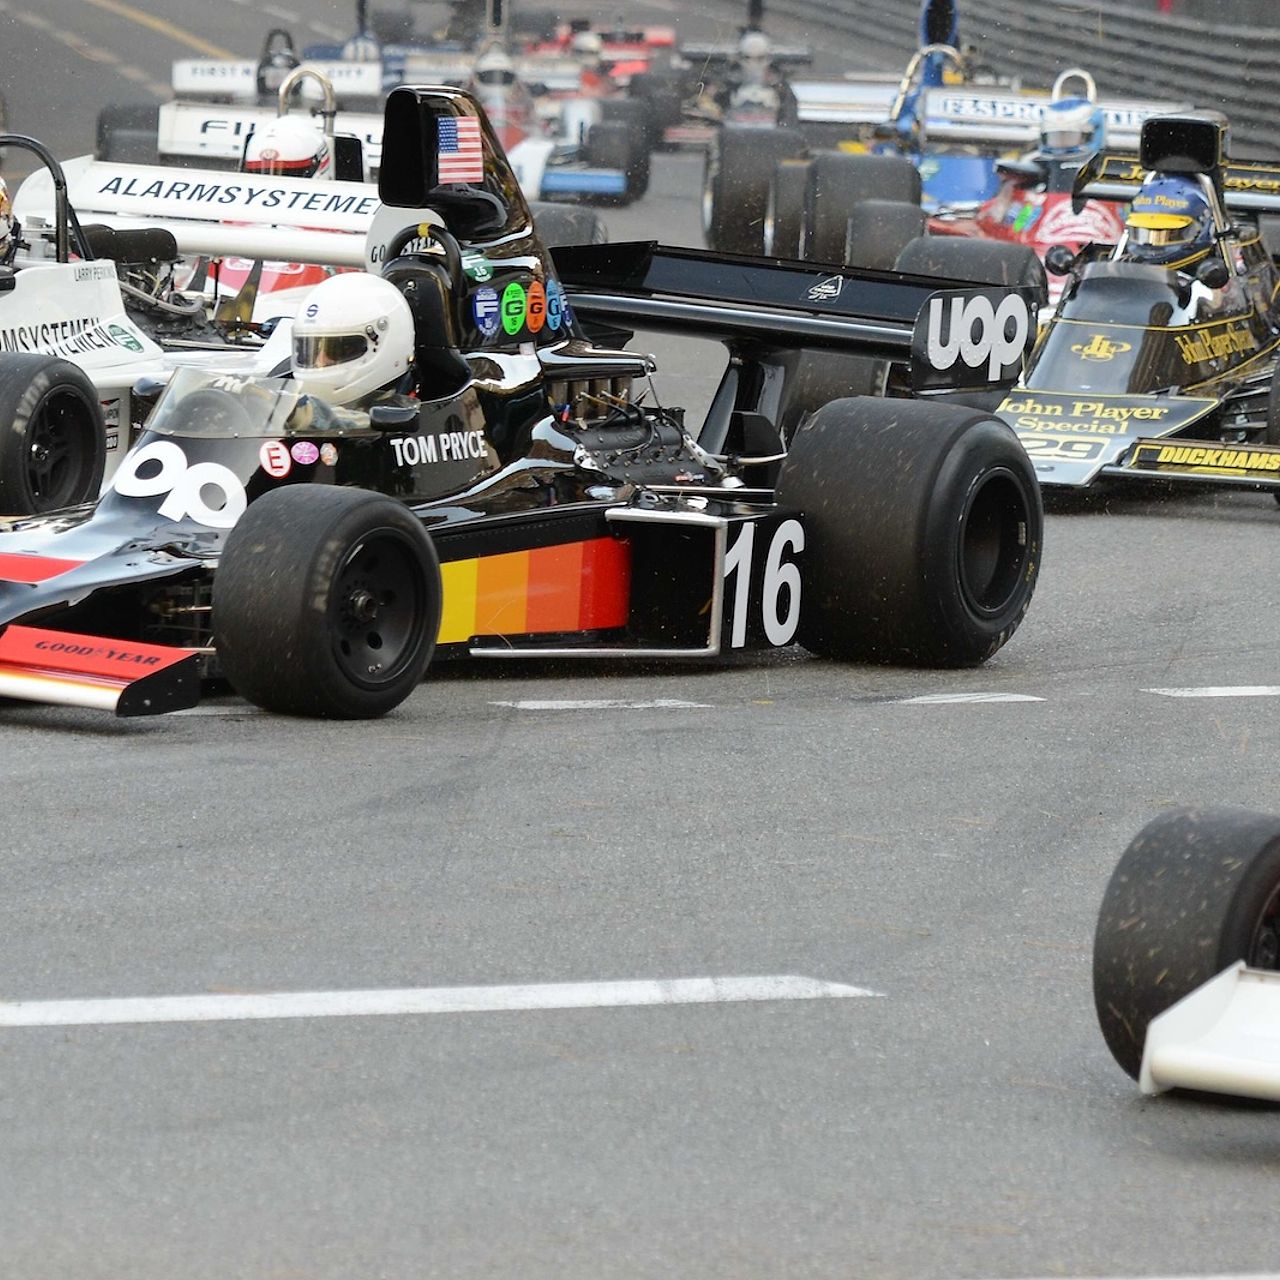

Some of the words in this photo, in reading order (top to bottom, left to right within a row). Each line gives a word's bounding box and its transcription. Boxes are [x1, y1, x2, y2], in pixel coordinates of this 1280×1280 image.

[99, 176, 384, 217] ALARMSYSTEME
[997, 398, 1062, 415] John
[1072, 402, 1169, 421] Player
[1015, 417, 1128, 434] Special
[390, 437, 437, 467] TOM
[440, 430, 488, 462] PRYCE
[1020, 438, 1099, 460] 29
[724, 518, 805, 650] 16
